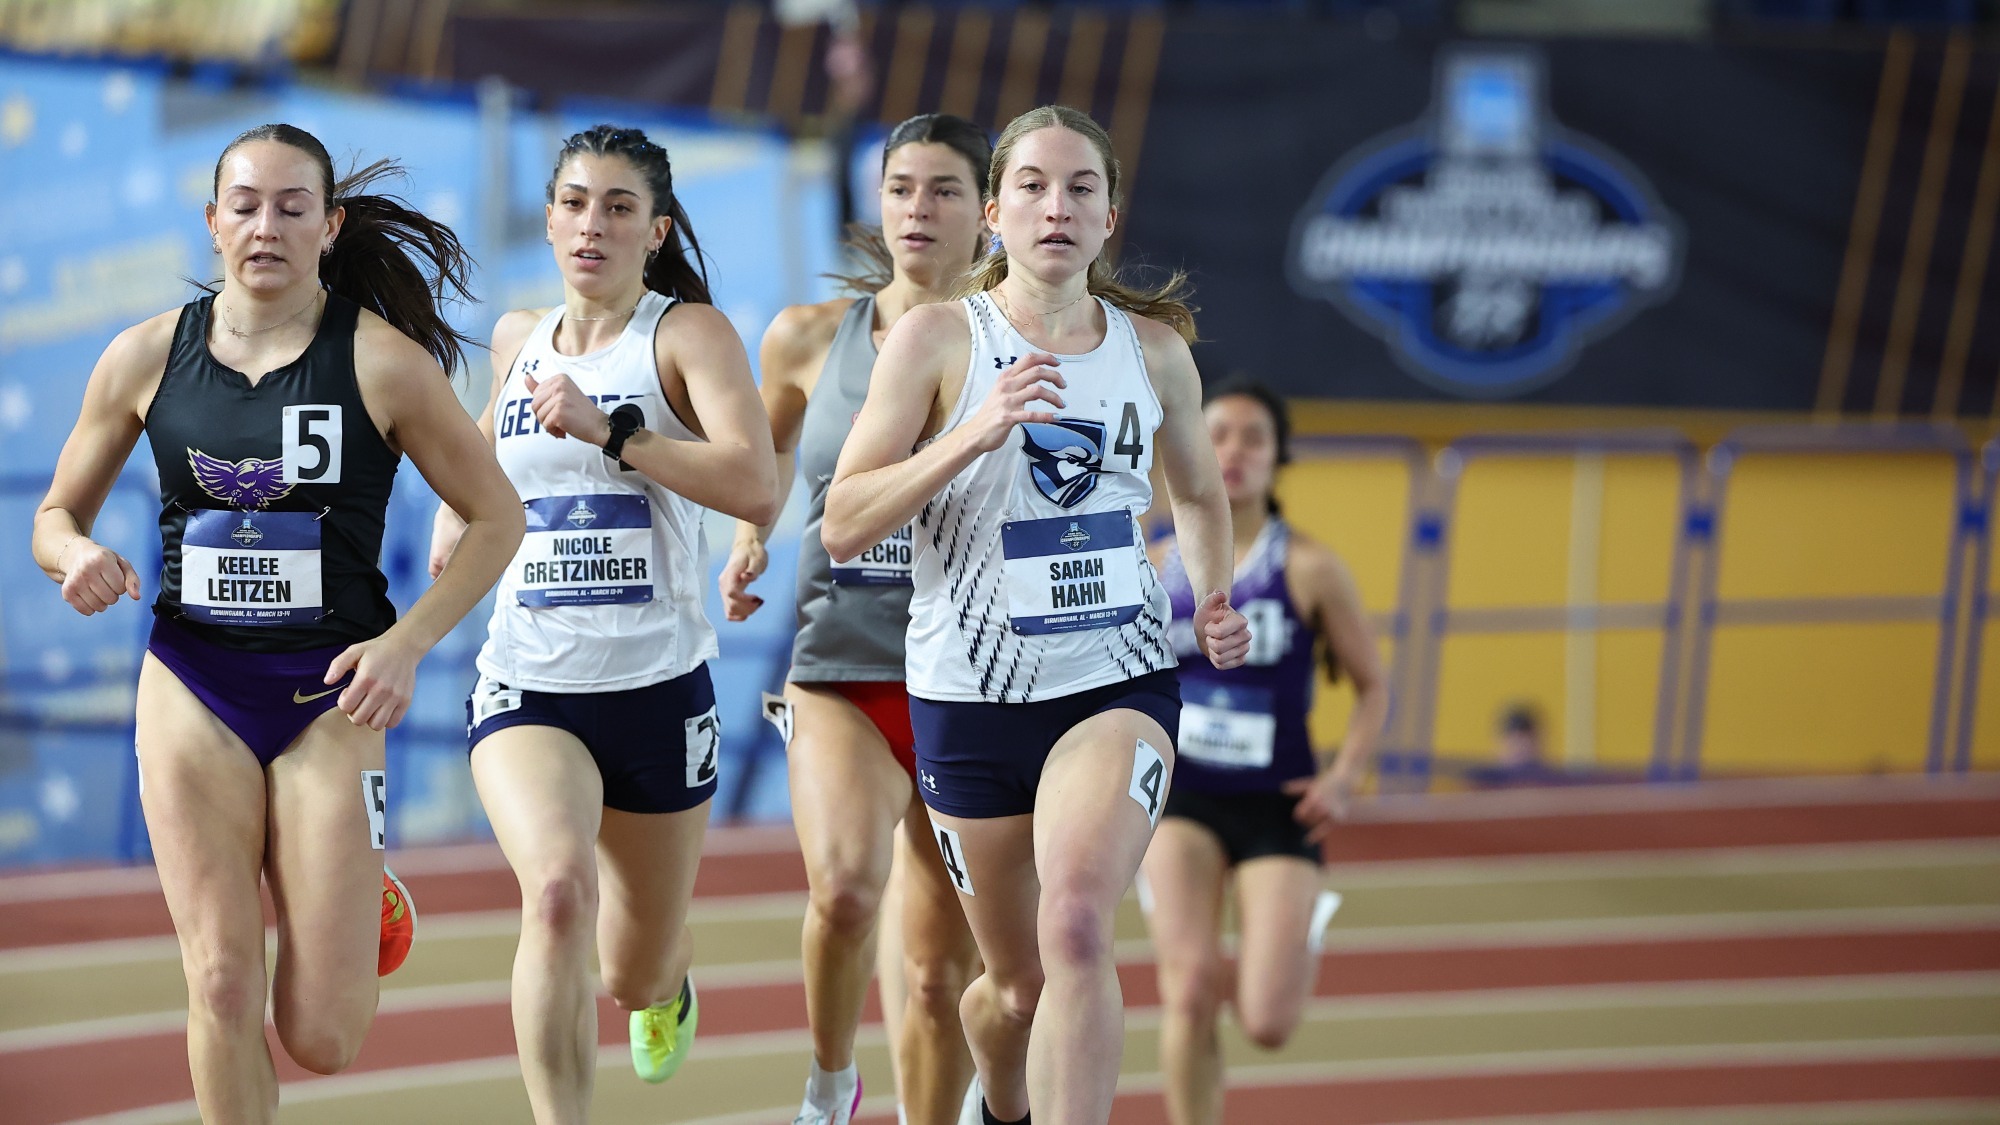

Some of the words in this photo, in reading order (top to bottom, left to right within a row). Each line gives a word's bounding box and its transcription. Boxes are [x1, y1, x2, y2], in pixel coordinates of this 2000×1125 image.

[298, 410, 331, 481] 5
[1114, 402, 1143, 470] 4
[553, 536, 612, 556] NICOLE
[218, 556, 279, 576] KEELEE
[524, 557, 647, 584] GRETZINGER
[1049, 557, 1104, 582] SARAH
[208, 578, 291, 603] LEITZEN
[1051, 580, 1106, 609] HAHN
[256, 610, 276, 618] MARCH
[1089, 611, 1105, 620] MARCH
[697, 716, 716, 783] 2
[1139, 758, 1163, 817] 4
[940, 829, 964, 889] 4
